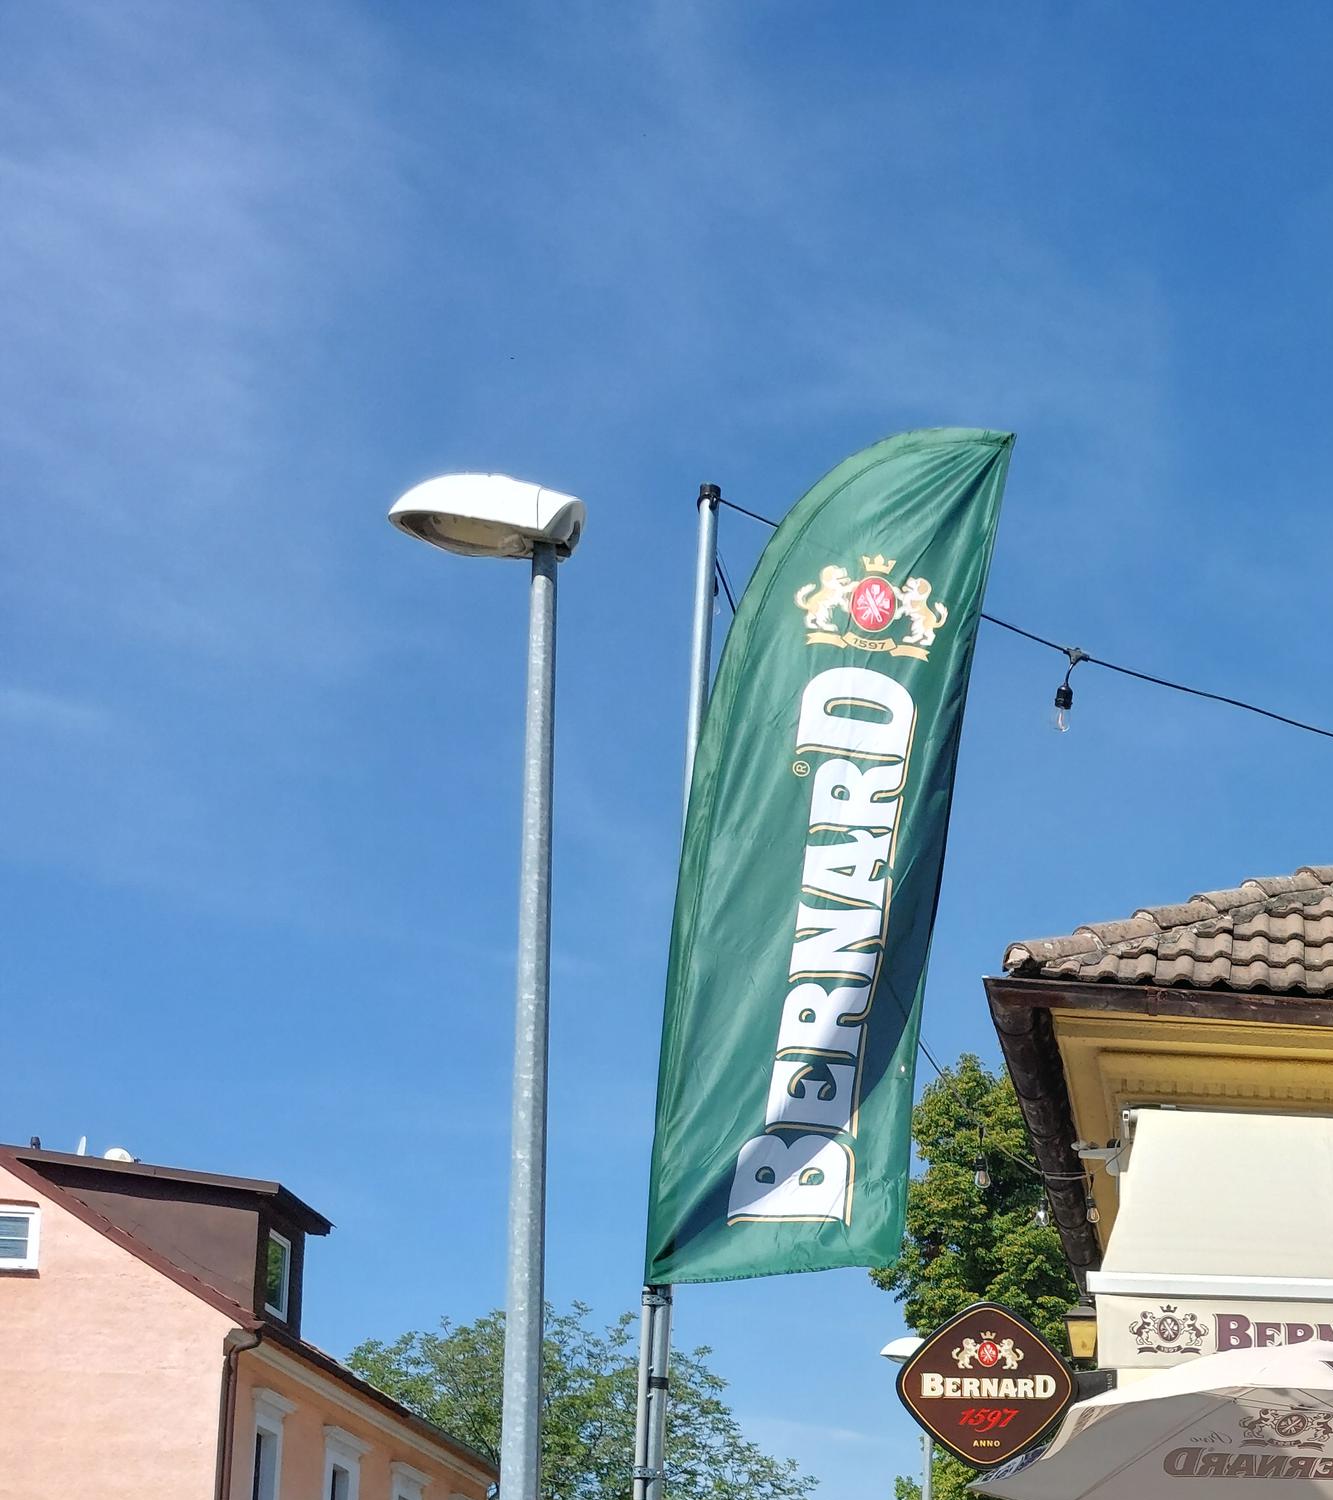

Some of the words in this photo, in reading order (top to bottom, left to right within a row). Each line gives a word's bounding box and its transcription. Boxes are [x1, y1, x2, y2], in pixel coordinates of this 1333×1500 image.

[853, 638, 886, 650] 1597
[727, 666, 918, 1227] BERNARD
[920, 1372, 1057, 1400] BERNARD
[959, 1407, 1021, 1433] 1597
[972, 1439, 1001, 1448] ANNO
